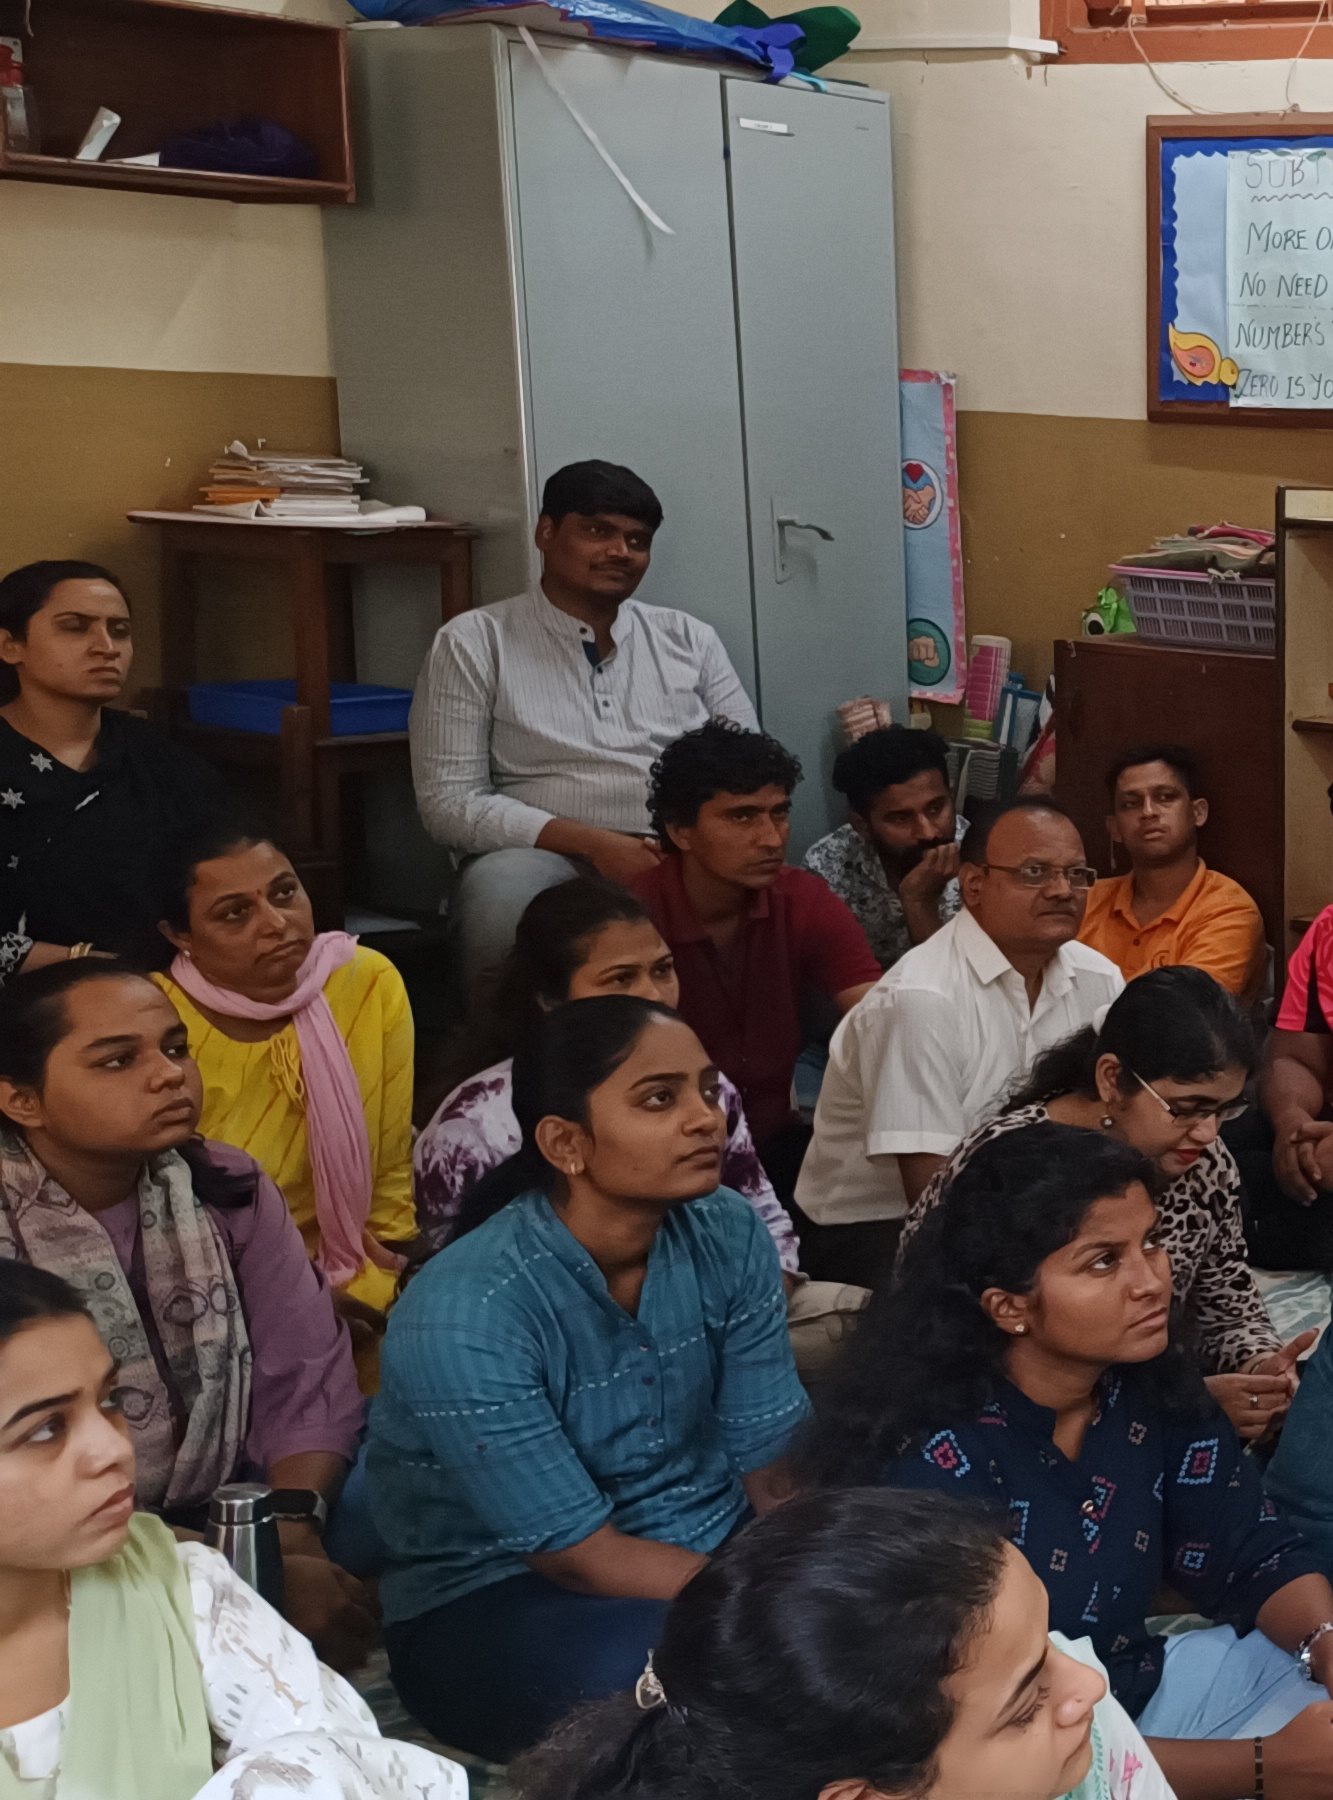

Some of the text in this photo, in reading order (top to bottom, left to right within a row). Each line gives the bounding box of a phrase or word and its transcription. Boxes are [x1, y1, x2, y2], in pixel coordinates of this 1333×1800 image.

[1246, 220, 1308, 255] MORE
[1239, 272, 1266, 298] NO
[1277, 273, 1328, 298] NEED
[1234, 368, 1278, 399] ZERO
[1287, 375, 1306, 399] IS
